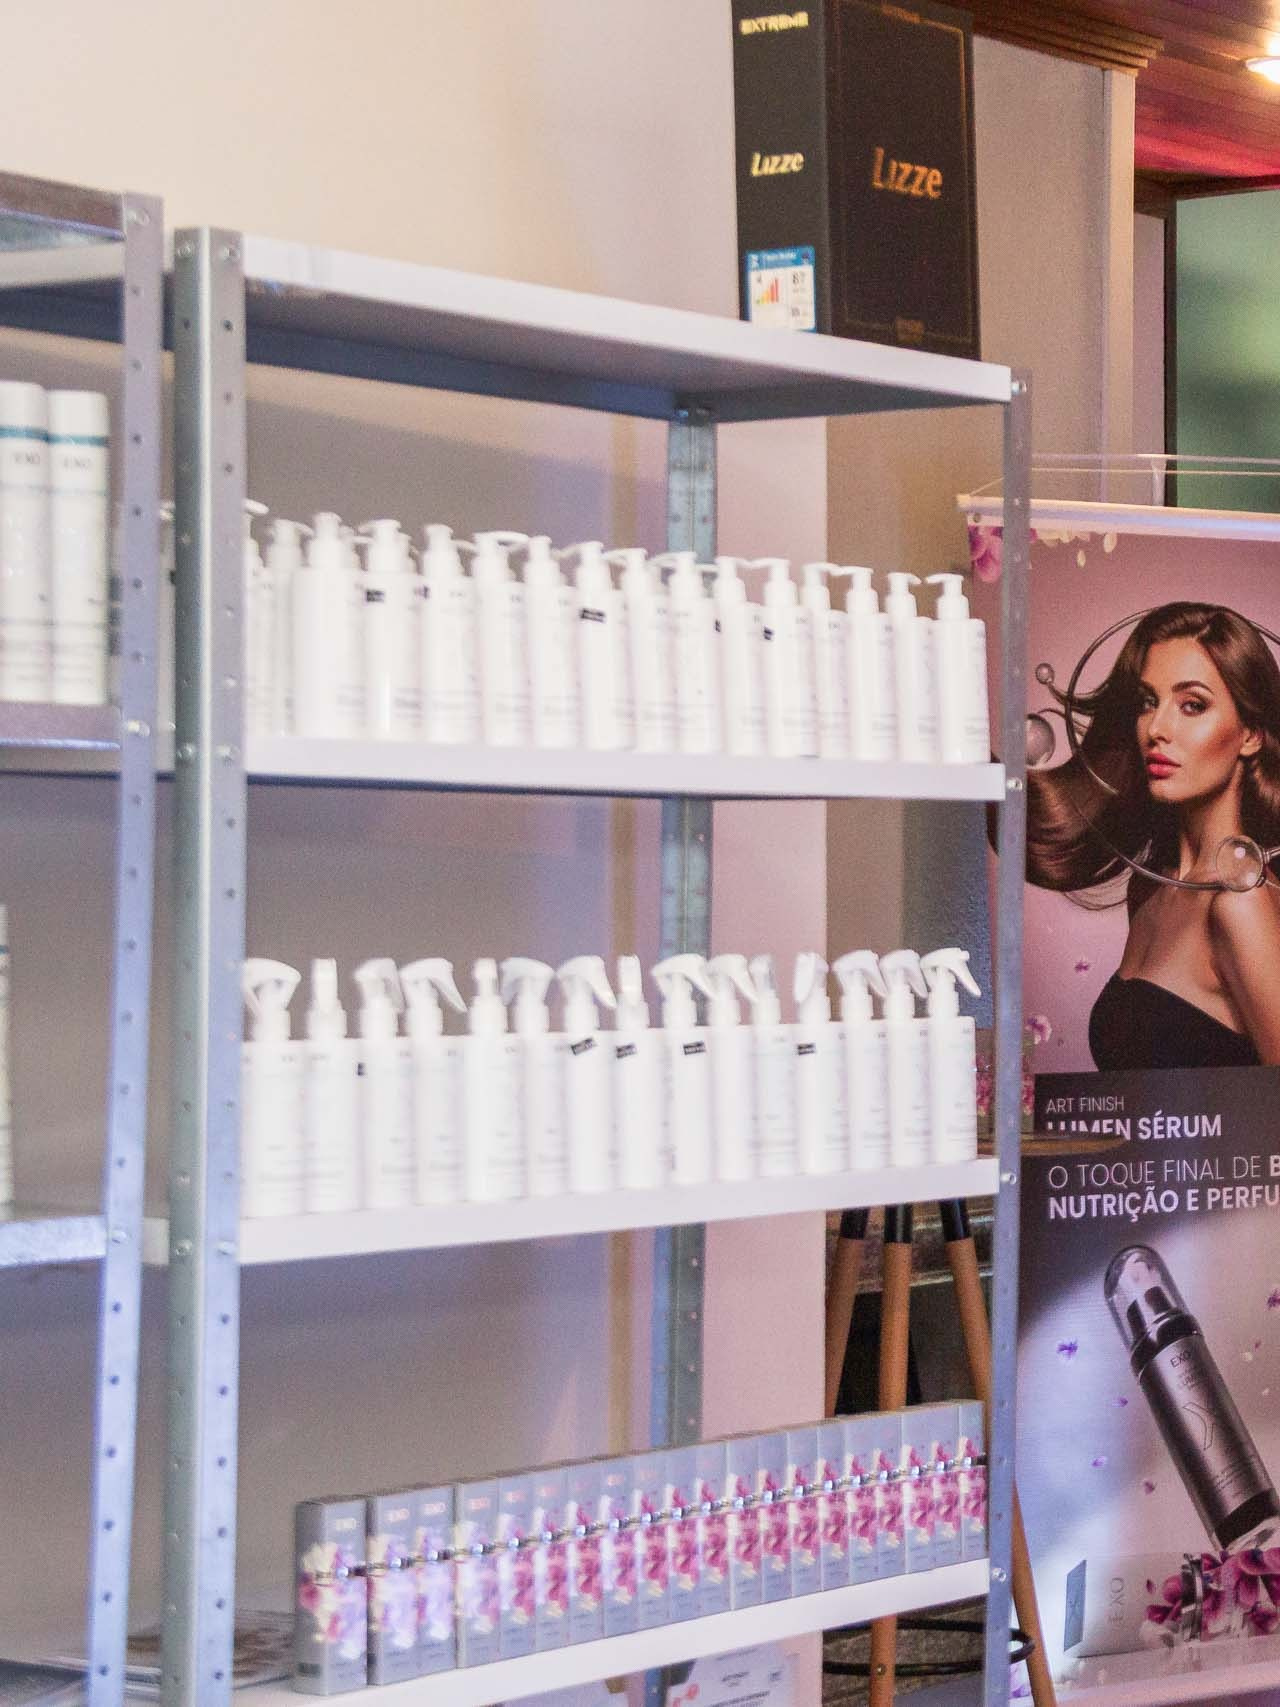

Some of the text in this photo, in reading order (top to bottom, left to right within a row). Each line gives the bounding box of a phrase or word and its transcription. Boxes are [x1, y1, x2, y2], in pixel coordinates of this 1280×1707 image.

[871, 147, 943, 198] Lizze
[1046, 1096, 1125, 1114] ART FINISH
[1137, 1109, 1222, 1140] SÉRUM
[1048, 1165, 1069, 1189] O
[1077, 1160, 1156, 1189] TOQUE
[1163, 1156, 1225, 1182] FINAL
[1232, 1155, 1262, 1179] DE
[1048, 1185, 1180, 1223] NUTRIÇÃO
[1186, 1188, 1200, 1211] E
